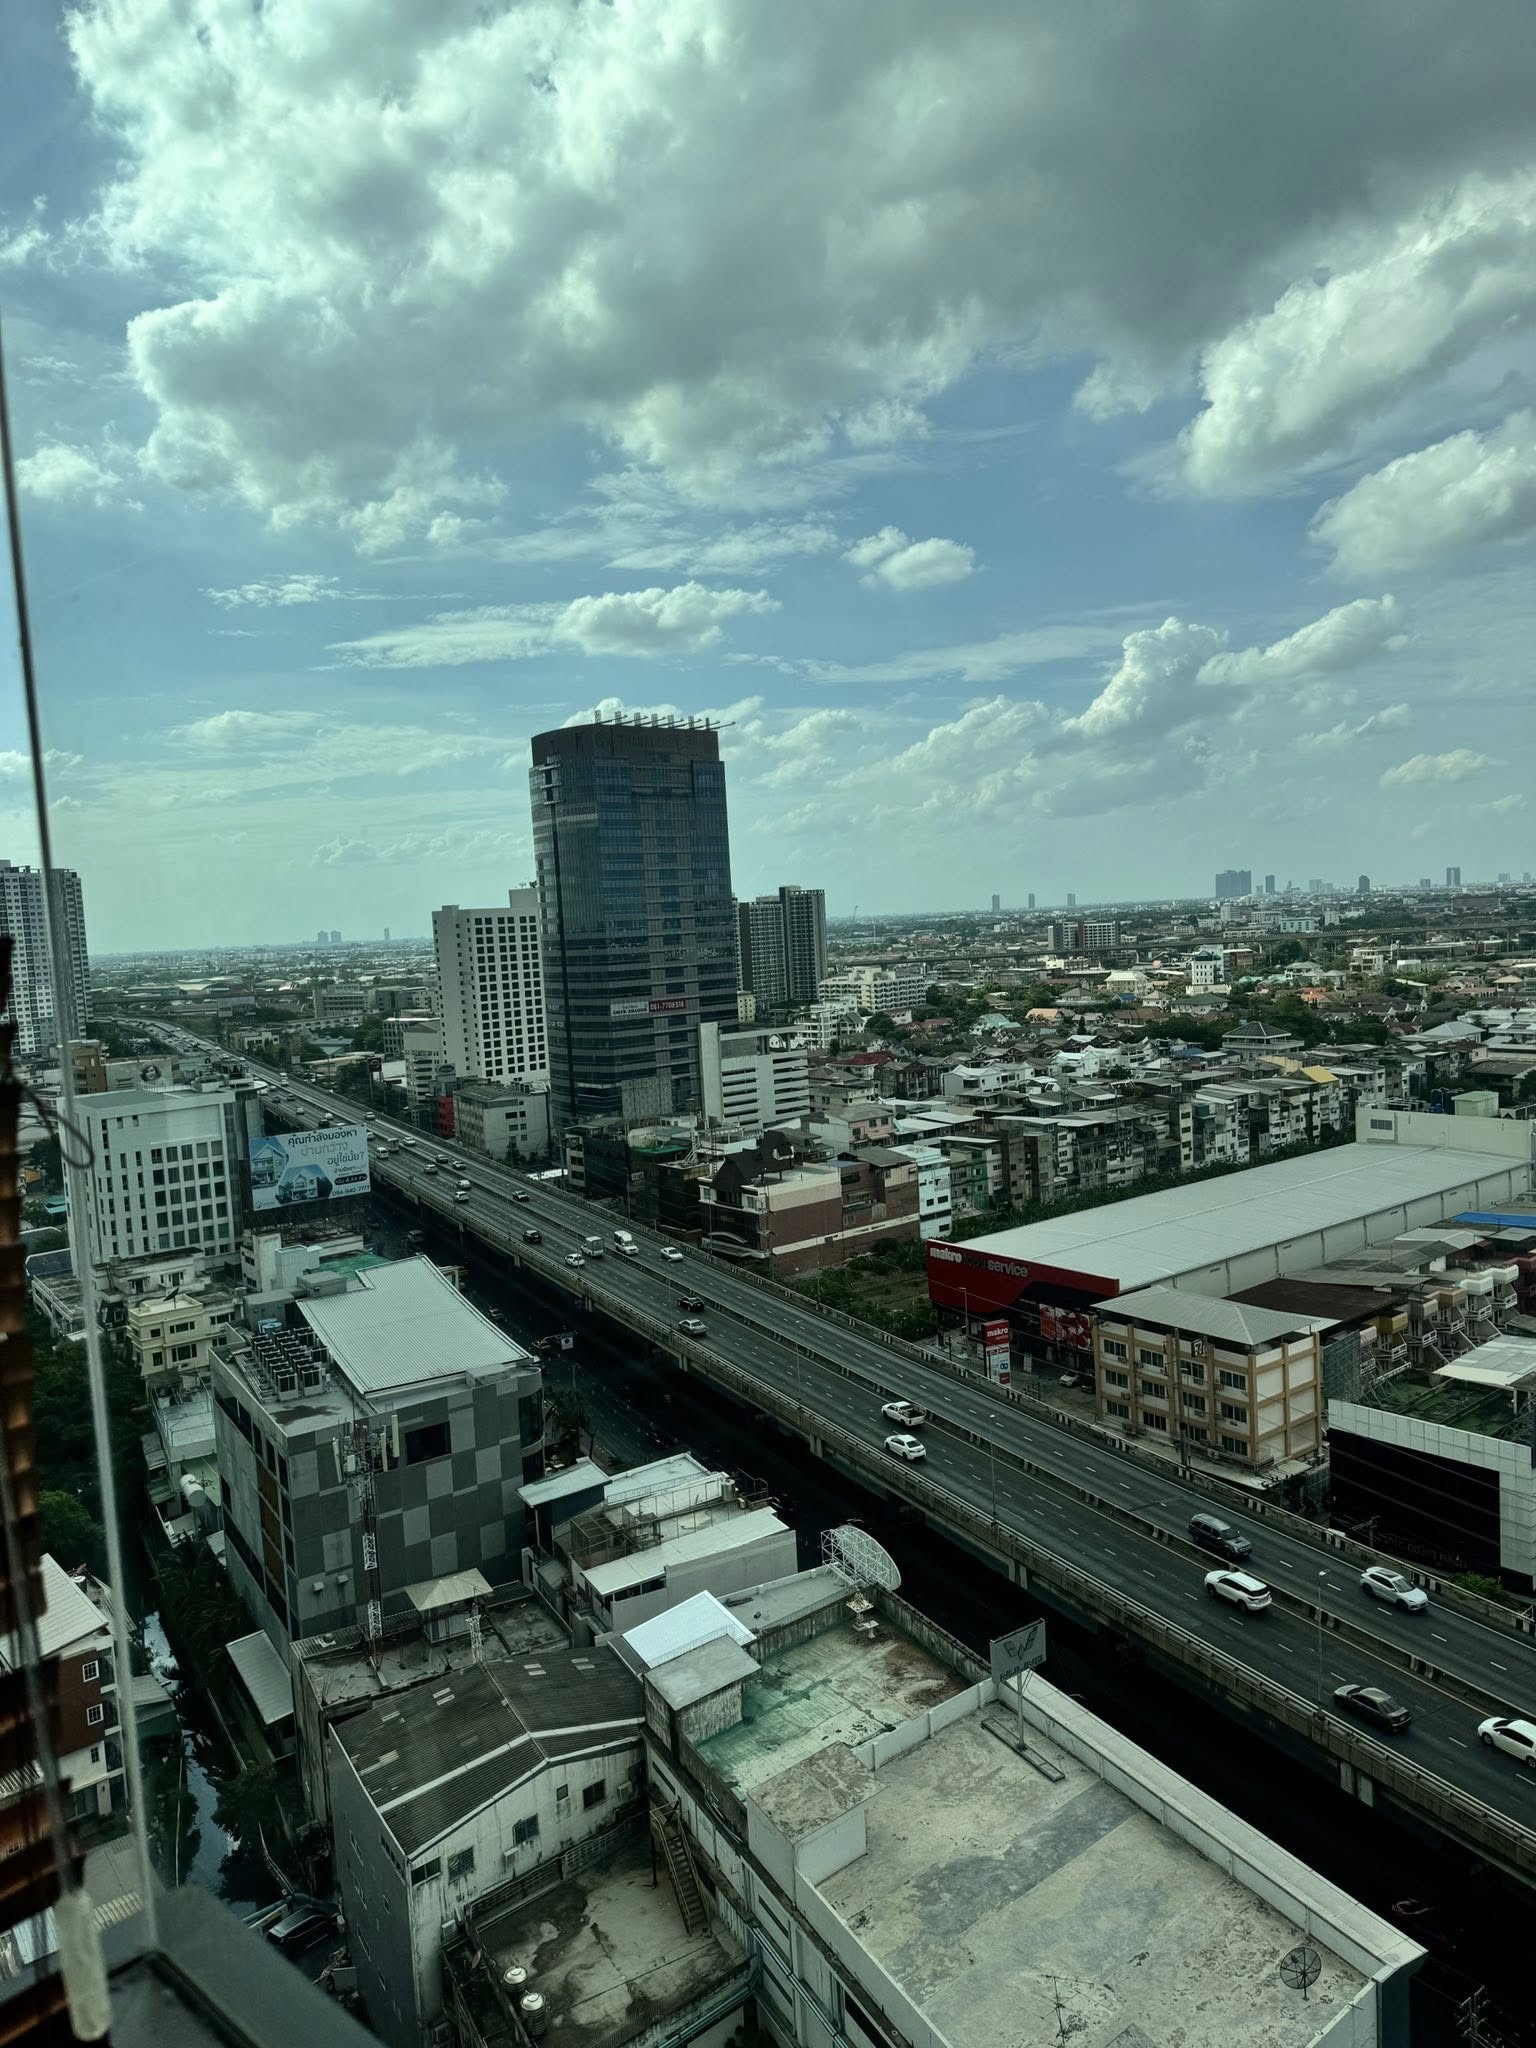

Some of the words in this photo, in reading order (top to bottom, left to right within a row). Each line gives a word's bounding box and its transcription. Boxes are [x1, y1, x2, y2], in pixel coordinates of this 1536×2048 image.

[930, 1247, 962, 1263] makro
[987, 1259, 1028, 1277] service
[987, 1328, 1009, 1337] makro
